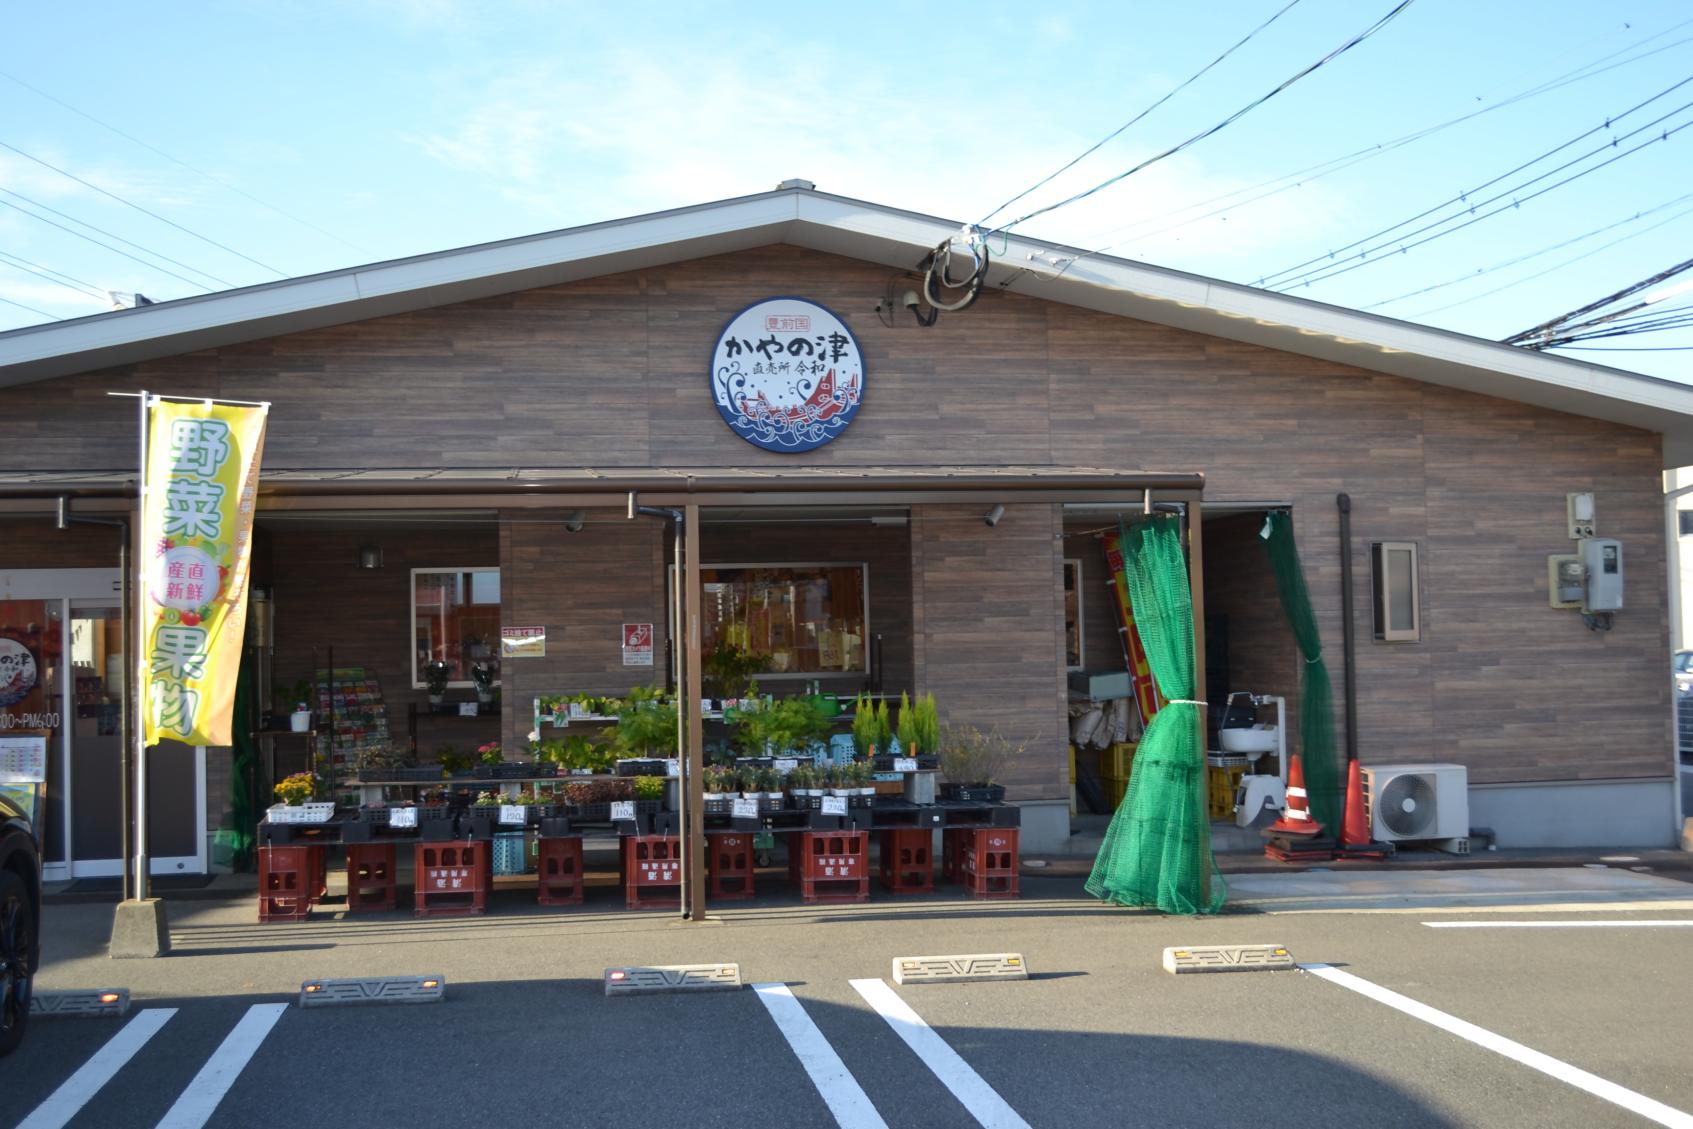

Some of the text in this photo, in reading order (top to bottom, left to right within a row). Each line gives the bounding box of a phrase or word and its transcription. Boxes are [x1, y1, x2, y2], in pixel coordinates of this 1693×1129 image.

[725, 331, 850, 364] かやの津
[752, 360, 826, 376] 直売所 令和
[163, 418, 230, 539] 野菜
[167, 561, 206, 580] 産直
[166, 582, 204, 601] 新鮮
[149, 625, 208, 737] 果物
